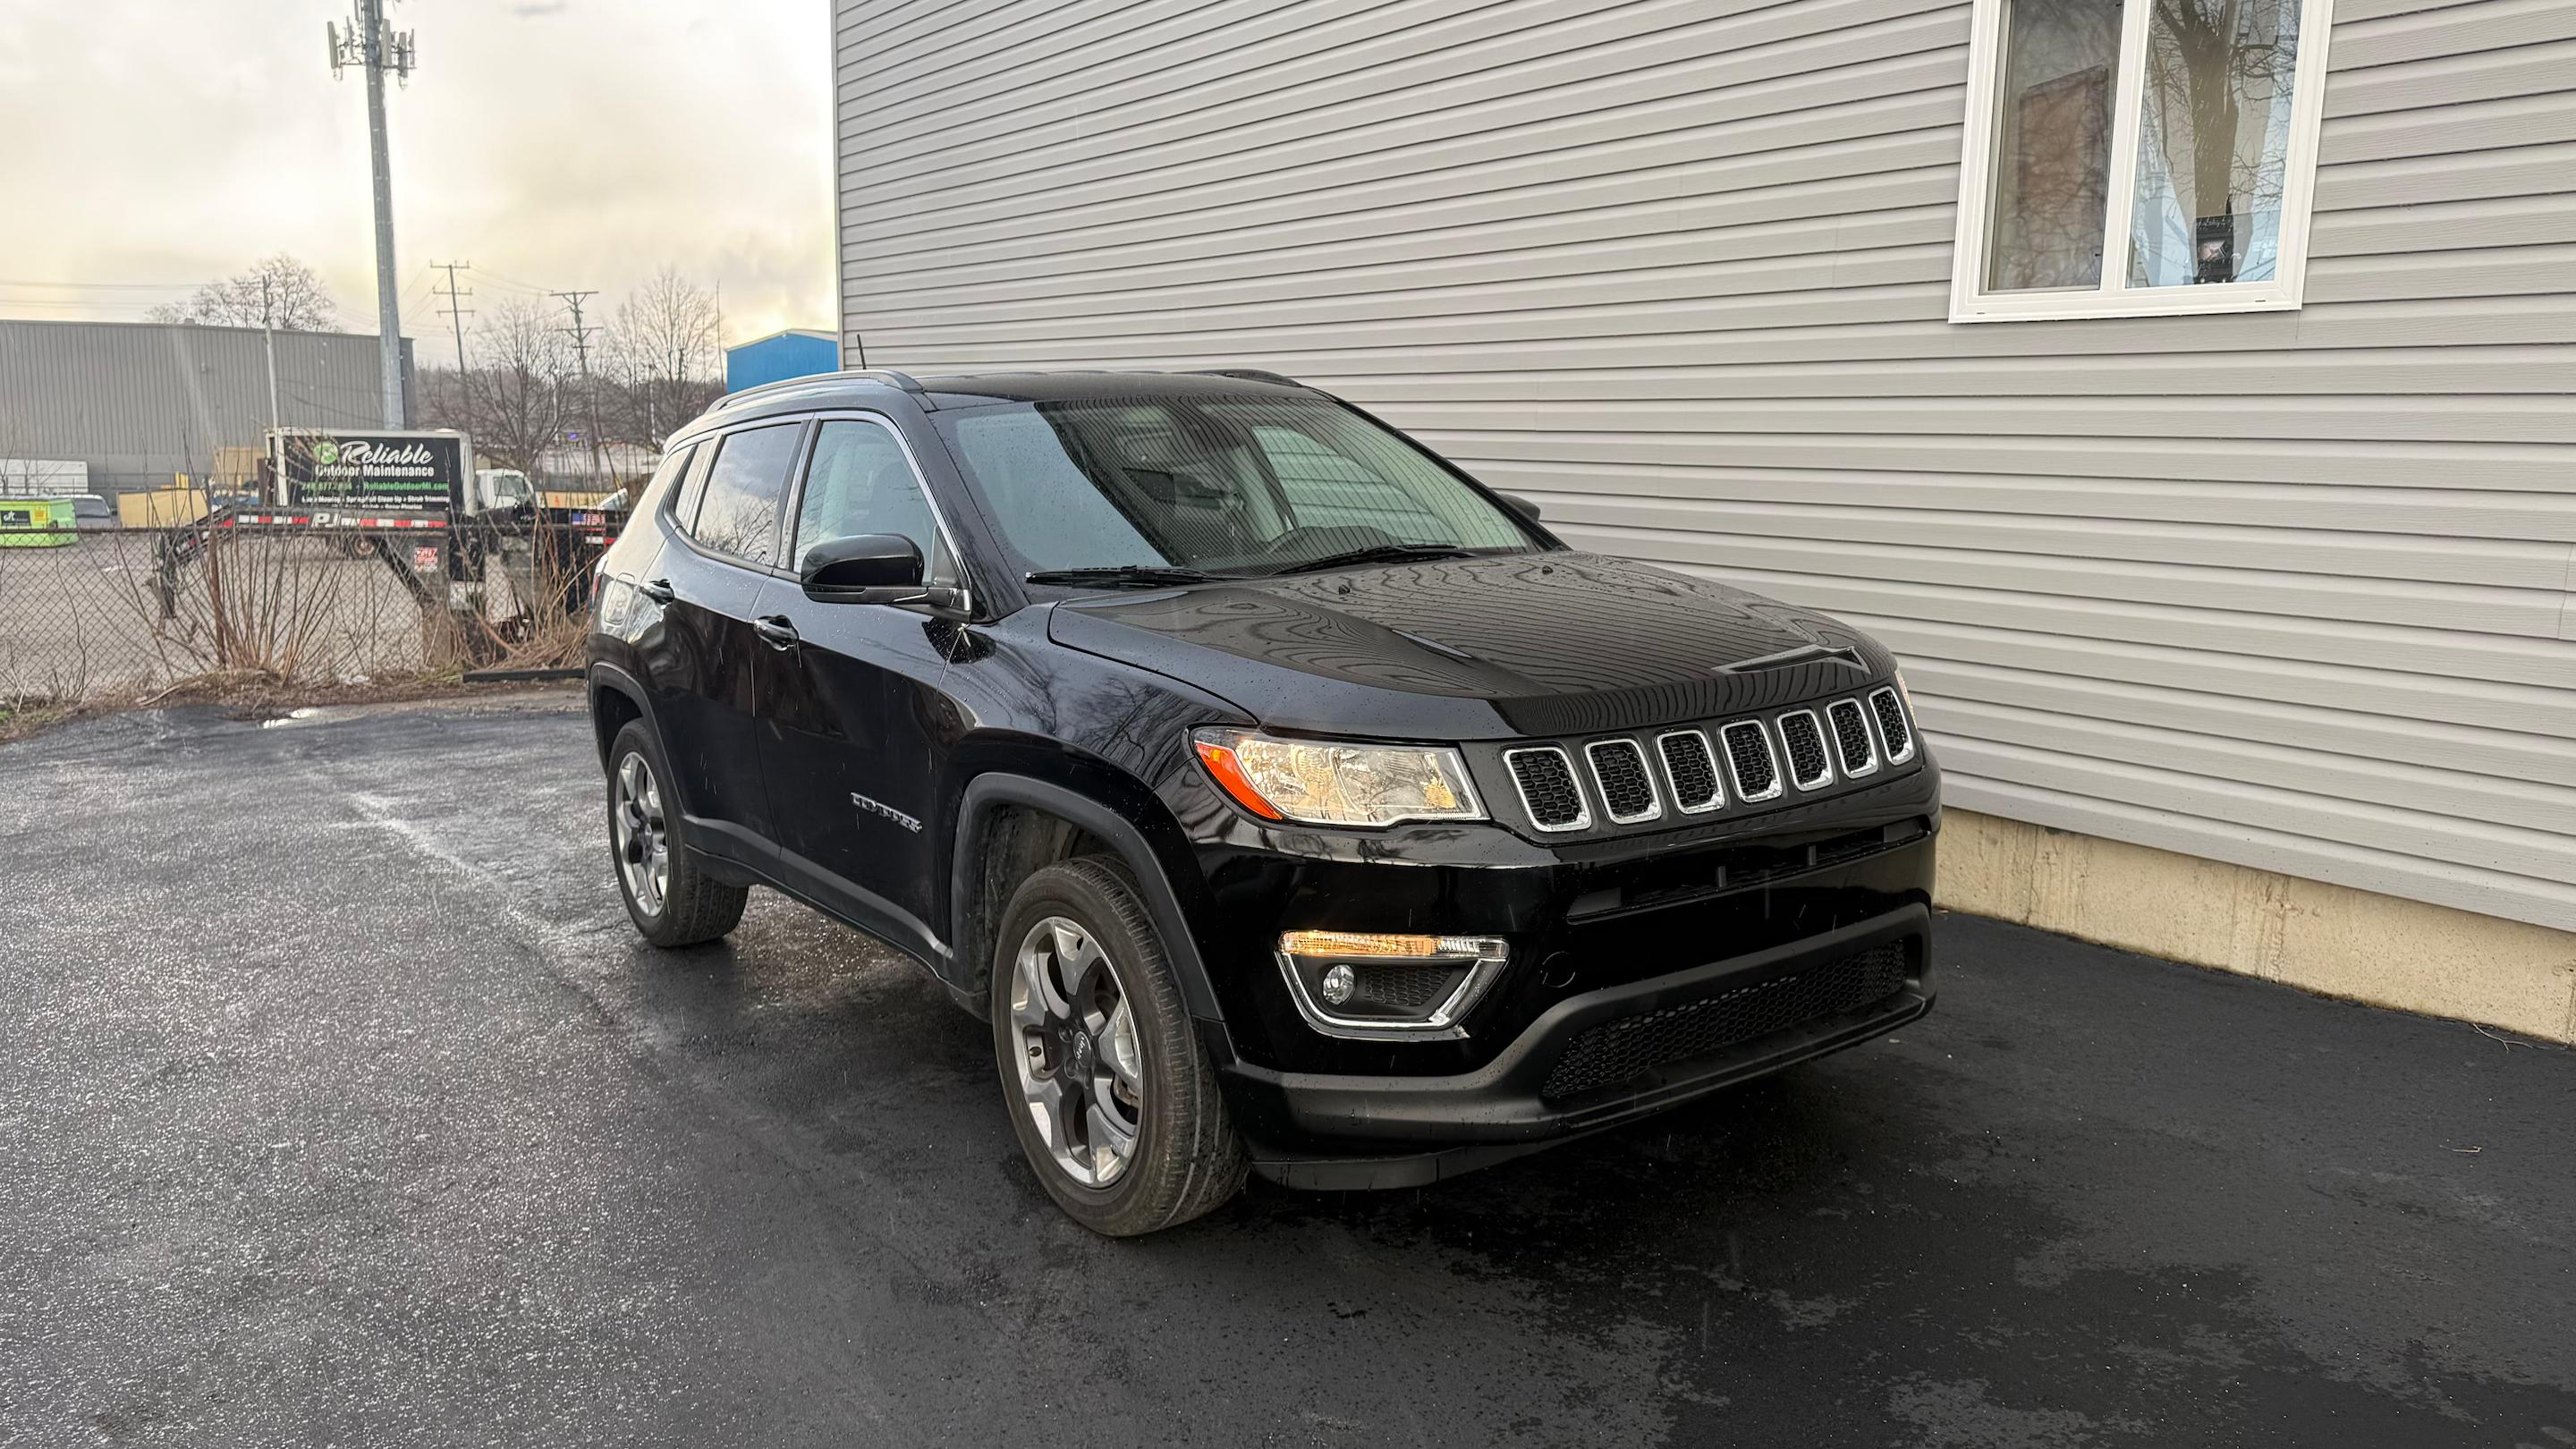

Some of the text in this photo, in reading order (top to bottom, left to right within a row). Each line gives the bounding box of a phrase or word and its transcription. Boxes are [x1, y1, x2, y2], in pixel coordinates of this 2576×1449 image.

[340, 440, 434, 464] Reliable
[315, 464, 435, 477] Outdoor Maintenance
